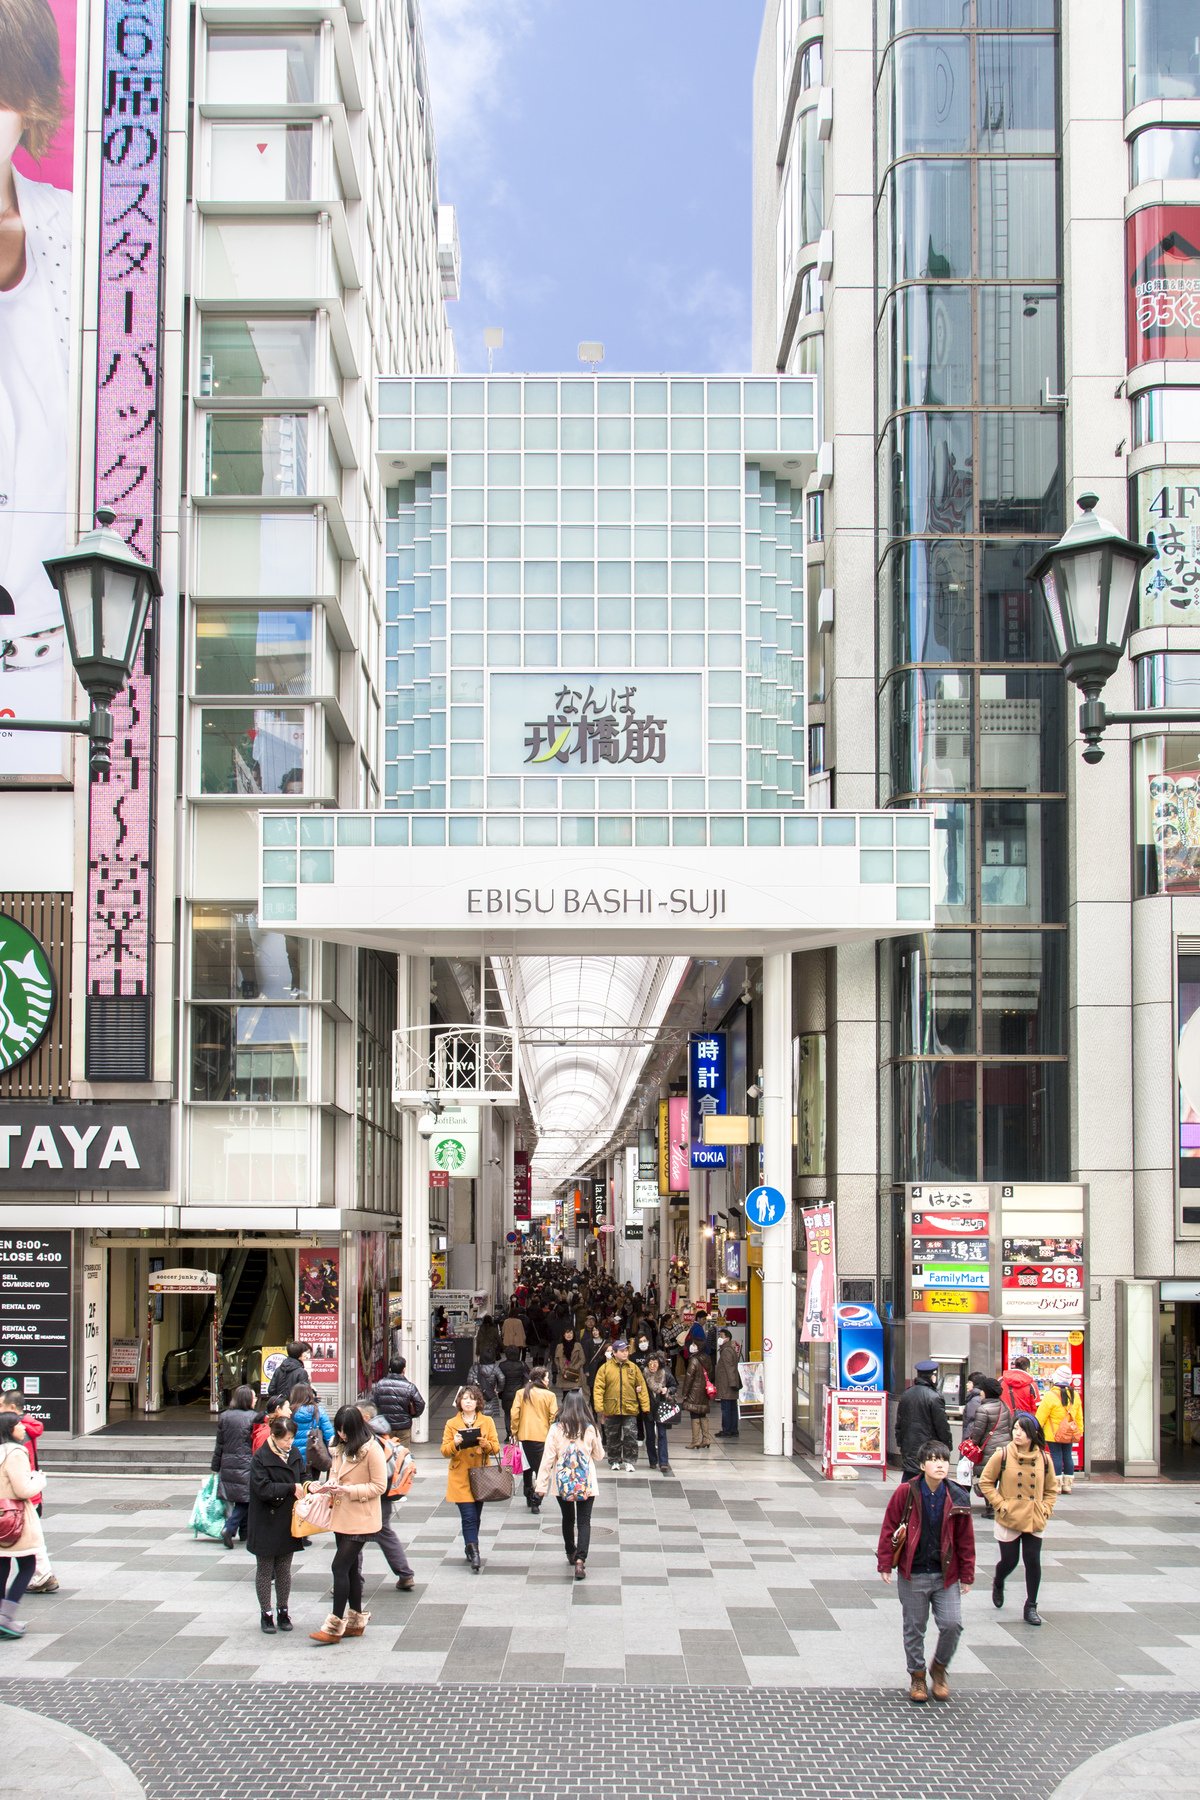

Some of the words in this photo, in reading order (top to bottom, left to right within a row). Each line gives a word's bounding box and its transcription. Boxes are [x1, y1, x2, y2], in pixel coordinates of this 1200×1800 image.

[1149, 486, 1200, 518] 4F
[554, 683, 638, 715] なんば
[523, 714, 668, 765] 戎橋筋
[467, 889, 555, 914] EBISU
[693, 1151, 725, 1162] TOKIA
[912, 1188, 921, 1197] 4
[928, 1191, 973, 1208] はなこ
[1004, 1187, 1012, 1197] 8
[914, 1214, 921, 1223] 3
[913, 1240, 921, 1249] 2
[1004, 1240, 1011, 1249] 6
[36, 1253, 62, 1262] 4:00
[915, 1265, 921, 1275] 1
[929, 1272, 984, 1285] FamilyMart
[1004, 1267, 1011, 1276] 5
[1041, 1267, 1079, 1284] 268
[88, 1302, 96, 1319] 2F
